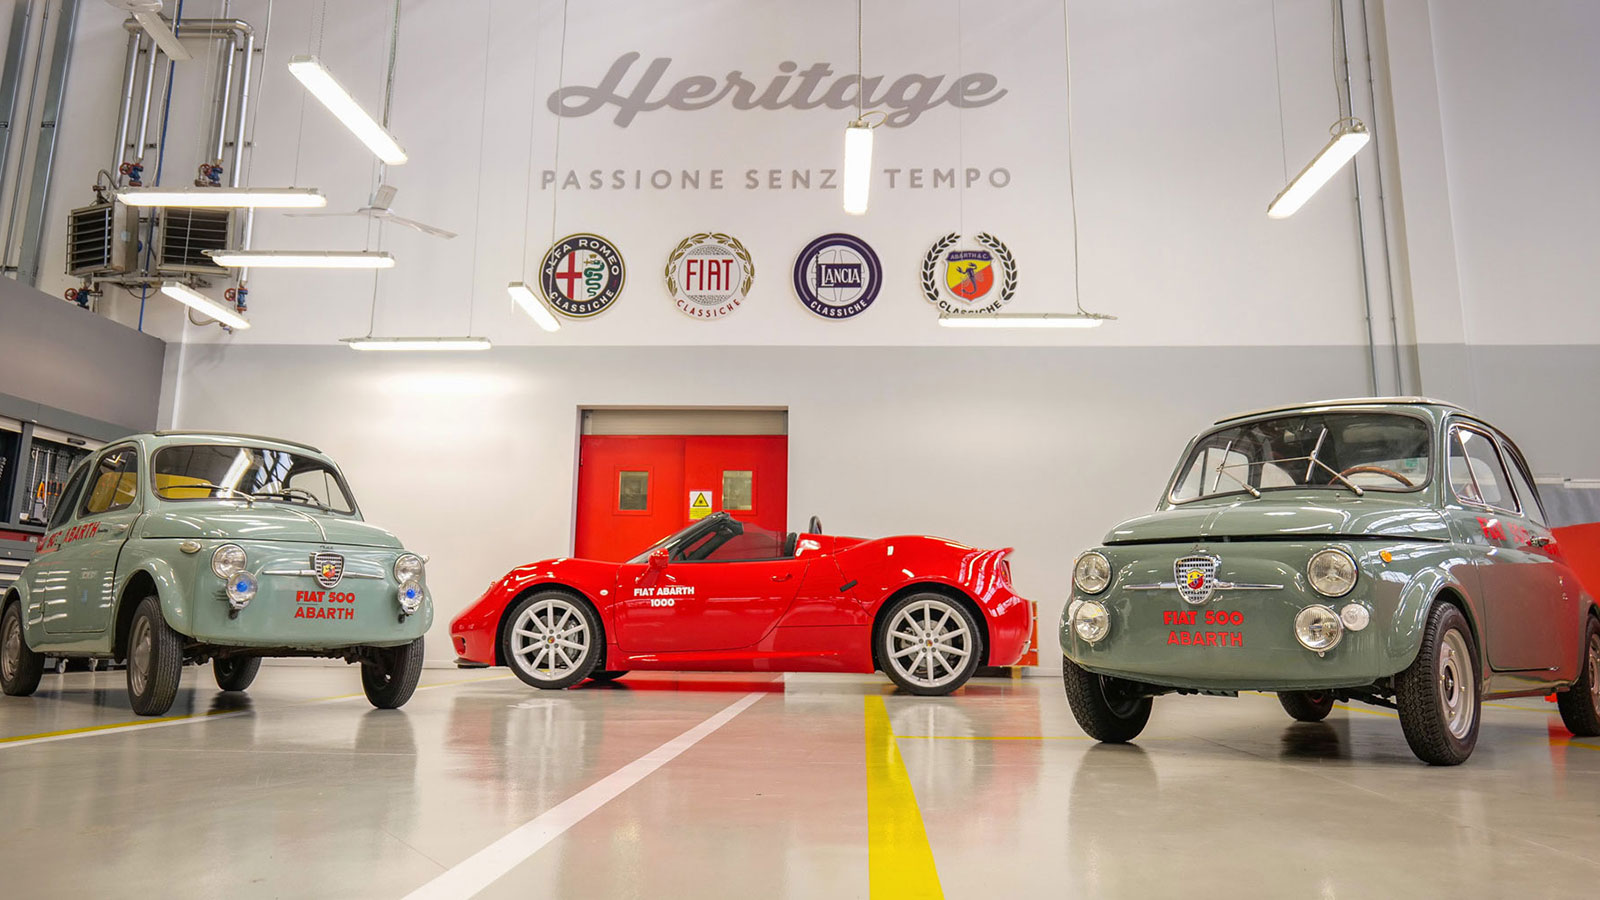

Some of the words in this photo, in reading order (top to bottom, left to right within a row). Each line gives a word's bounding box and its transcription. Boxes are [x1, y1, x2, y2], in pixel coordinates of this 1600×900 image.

[547, 51, 1008, 128] Heritage
[541, 169, 724, 190] PASSIONE
[745, 169, 837, 190] SENZ
[884, 168, 1011, 189] TEMPO
[545, 243, 572, 276] ALFA
[578, 239, 620, 275] ROMEO
[685, 259, 734, 291] FIAT
[820, 264, 861, 287] LANCIA
[550, 289, 614, 312] CLASSICHE
[676, 298, 741, 318] CLASSICHE
[810, 299, 867, 317] CLASSICHE
[295, 590, 326, 603] FIAT
[328, 591, 356, 604] 500
[633, 587, 655, 597] FIAT
[656, 586, 695, 596] ABARTH
[650, 598, 675, 607] 1000
[294, 606, 355, 620] ABARTH
[1163, 610, 1197, 625] FIAT
[1205, 610, 1245, 626] 500
[1167, 630, 1243, 647] ABARTH
